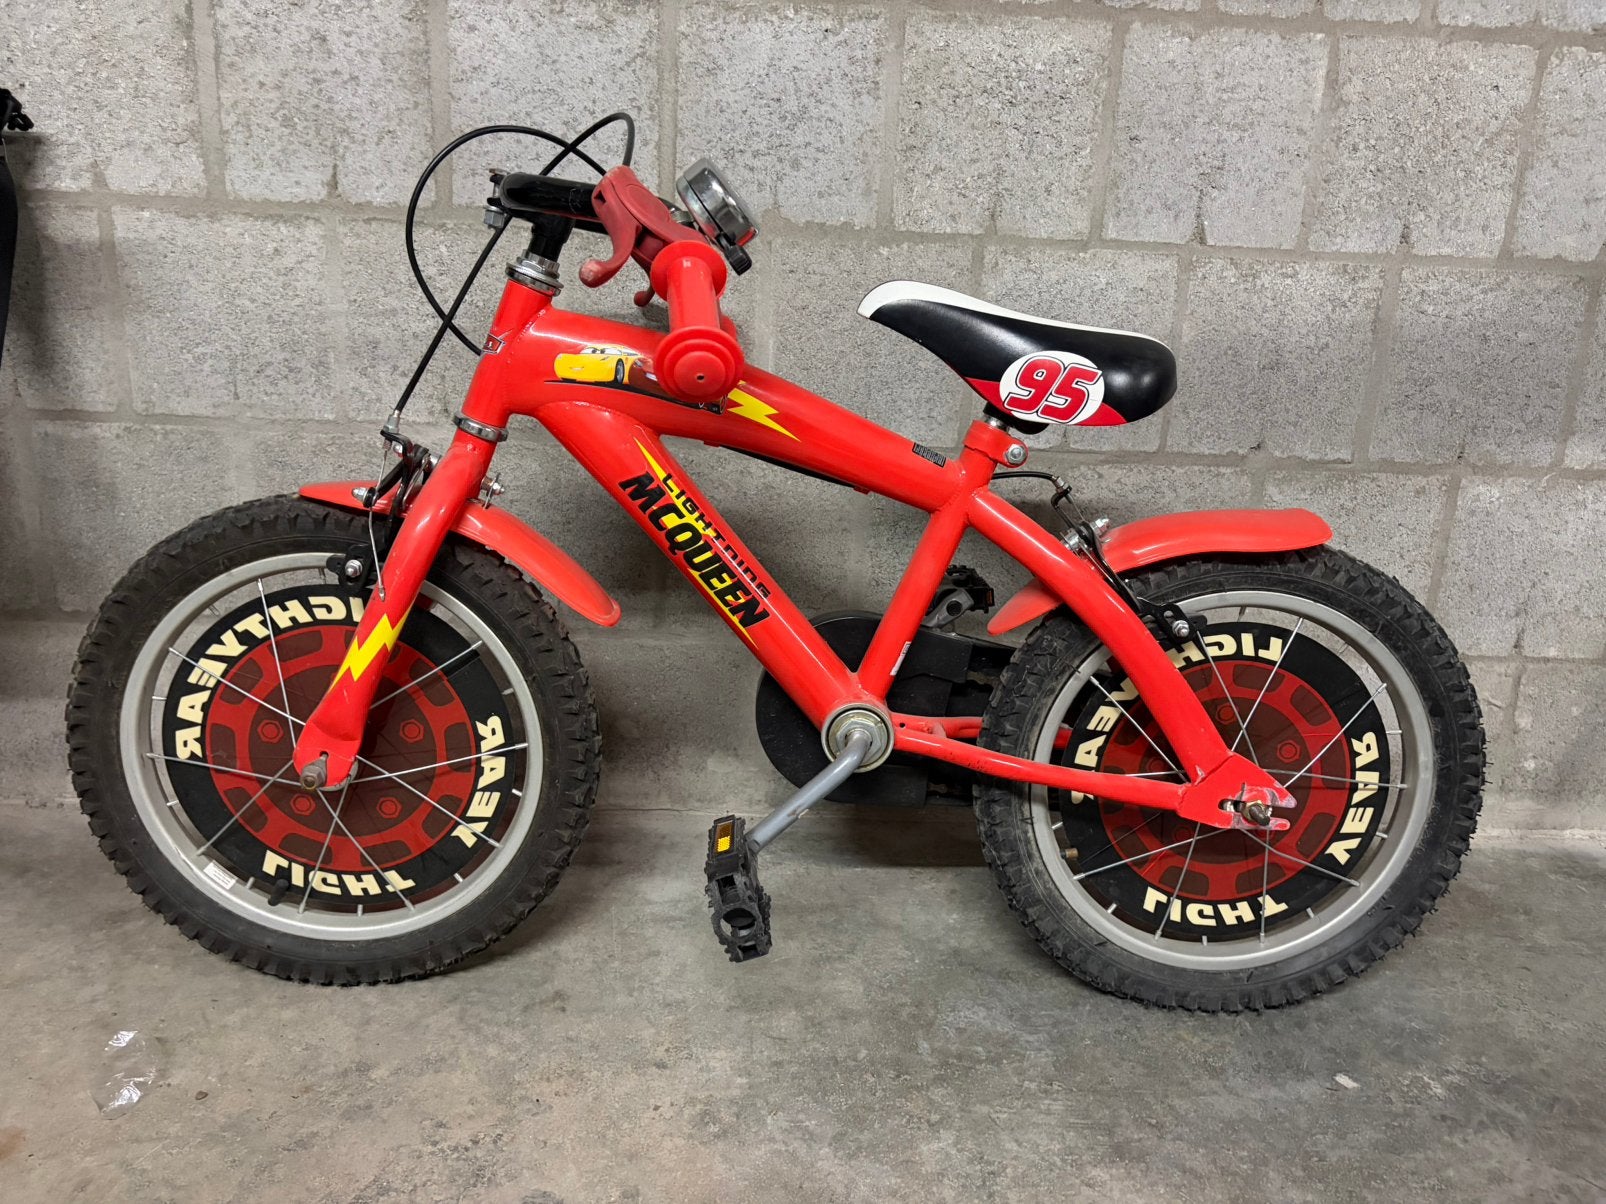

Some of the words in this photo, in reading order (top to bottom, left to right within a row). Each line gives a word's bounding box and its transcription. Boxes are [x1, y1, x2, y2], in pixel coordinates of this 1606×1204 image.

[1003, 355, 1102, 424] 95
[619, 471, 770, 628] MCQUEEN
[662, 473, 771, 599] LIGHTNING
